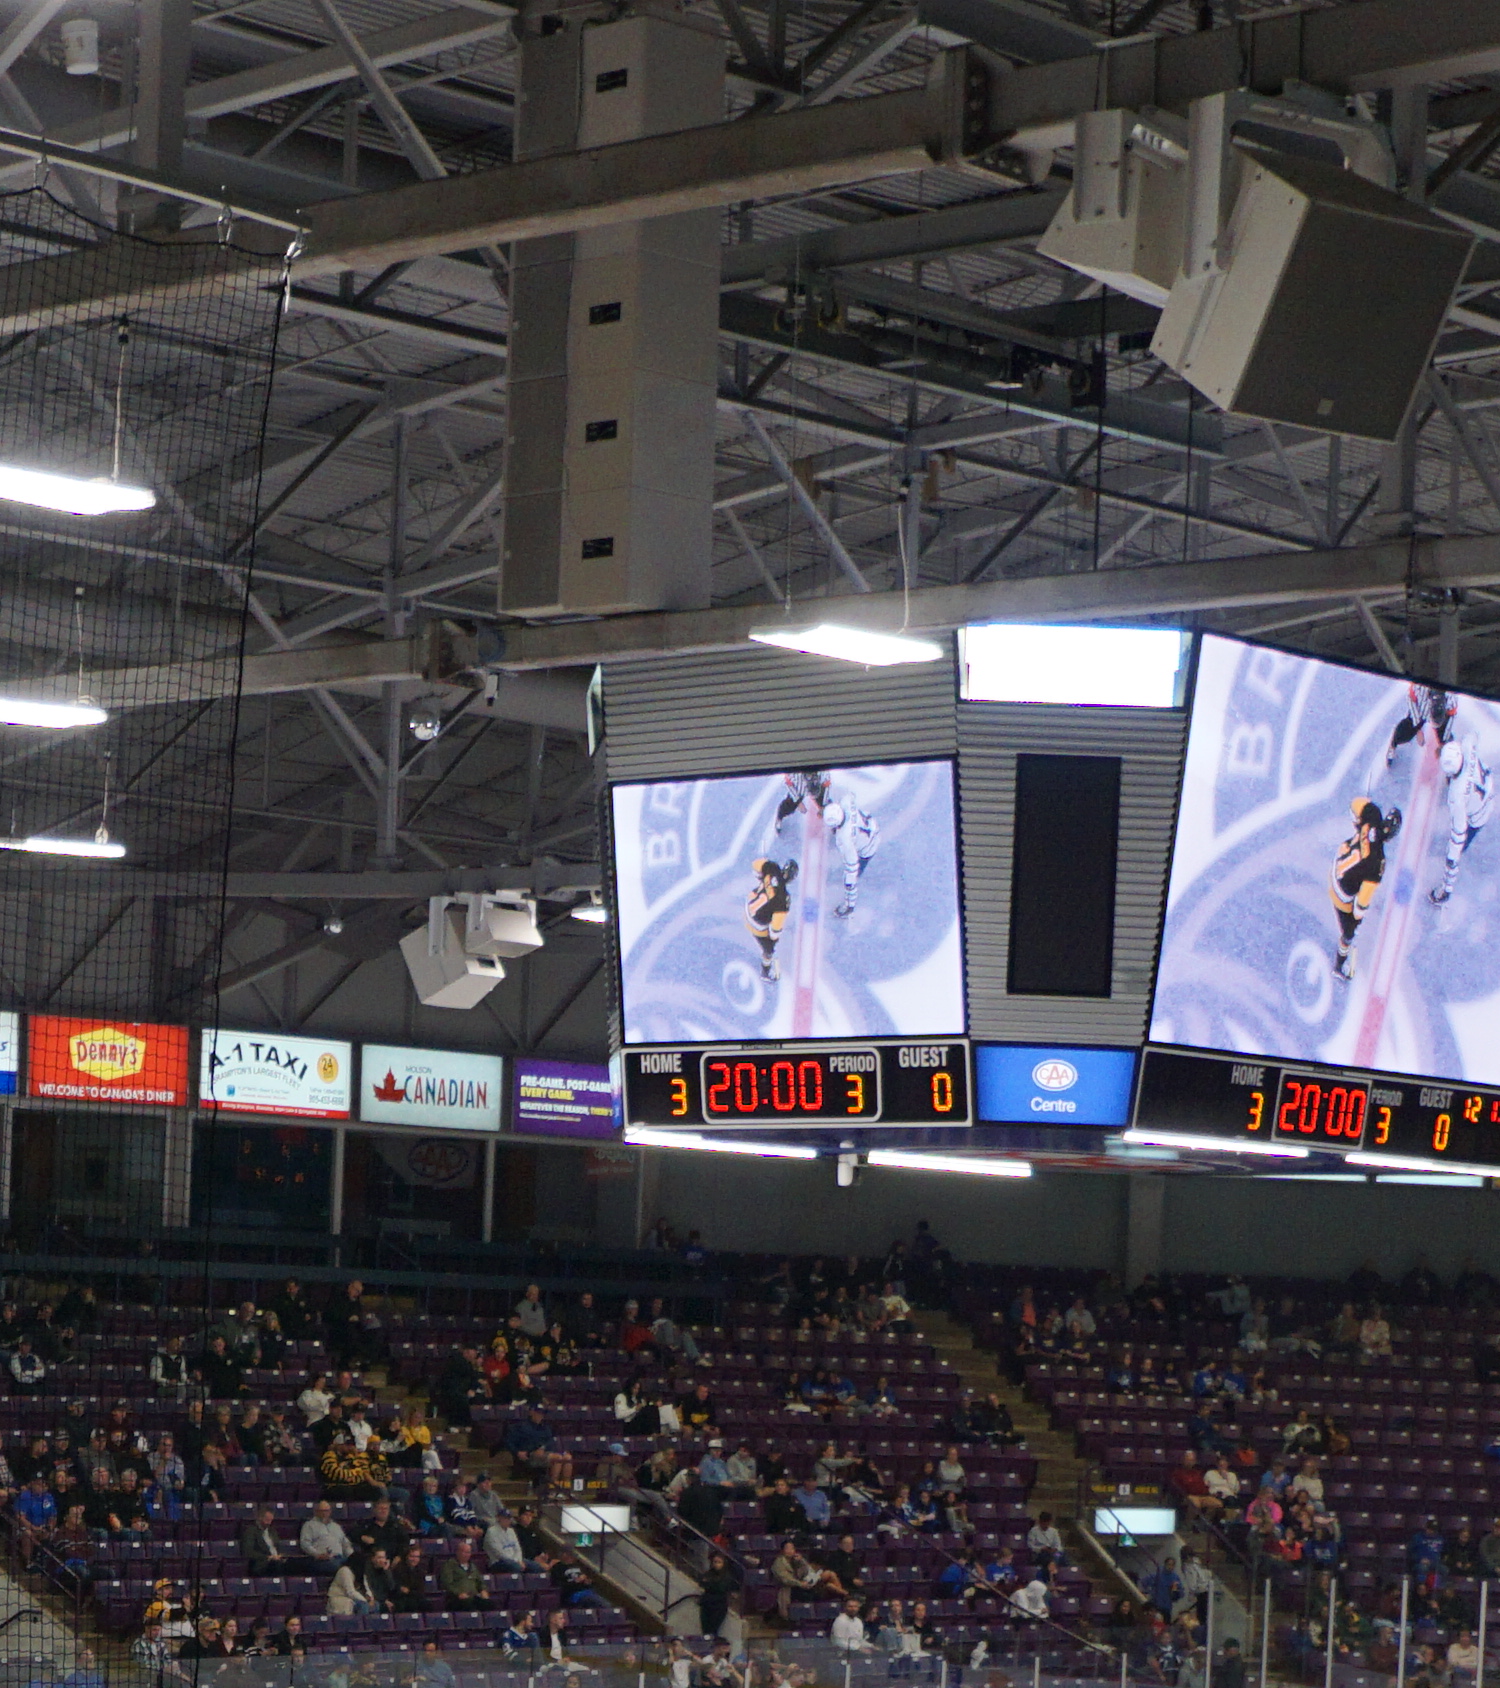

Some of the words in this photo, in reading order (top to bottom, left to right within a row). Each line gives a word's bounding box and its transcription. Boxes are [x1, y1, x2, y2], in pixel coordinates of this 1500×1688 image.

[76, 1040, 139, 1067] Denny's
[250, 1042, 308, 1080] TAXI
[640, 1053, 682, 1074] HOME
[829, 1055, 875, 1073] PERIOD
[899, 1046, 948, 1069] GUEST
[708, 1060, 823, 1113] 20:00
[1039, 1065, 1069, 1086] CAA
[1231, 1065, 1265, 1087] HOME
[39, 1084, 83, 1098] WELCOME
[100, 1085, 144, 1101] CANADA'S
[147, 1087, 174, 1102] DINER
[405, 1075, 488, 1110] CANADIAN
[670, 1078, 688, 1116] 3
[846, 1075, 863, 1114] 3
[932, 1072, 953, 1113] 0
[1030, 1096, 1077, 1114] Centre
[1371, 1088, 1404, 1107] PERIOD
[1420, 1087, 1454, 1109] GUEST
[1247, 1092, 1264, 1131] 3
[1278, 1082, 1368, 1138] 20:00
[1463, 1096, 1483, 1123] 12
[1375, 1106, 1391, 1144] 3
[1432, 1114, 1451, 1151] 0
